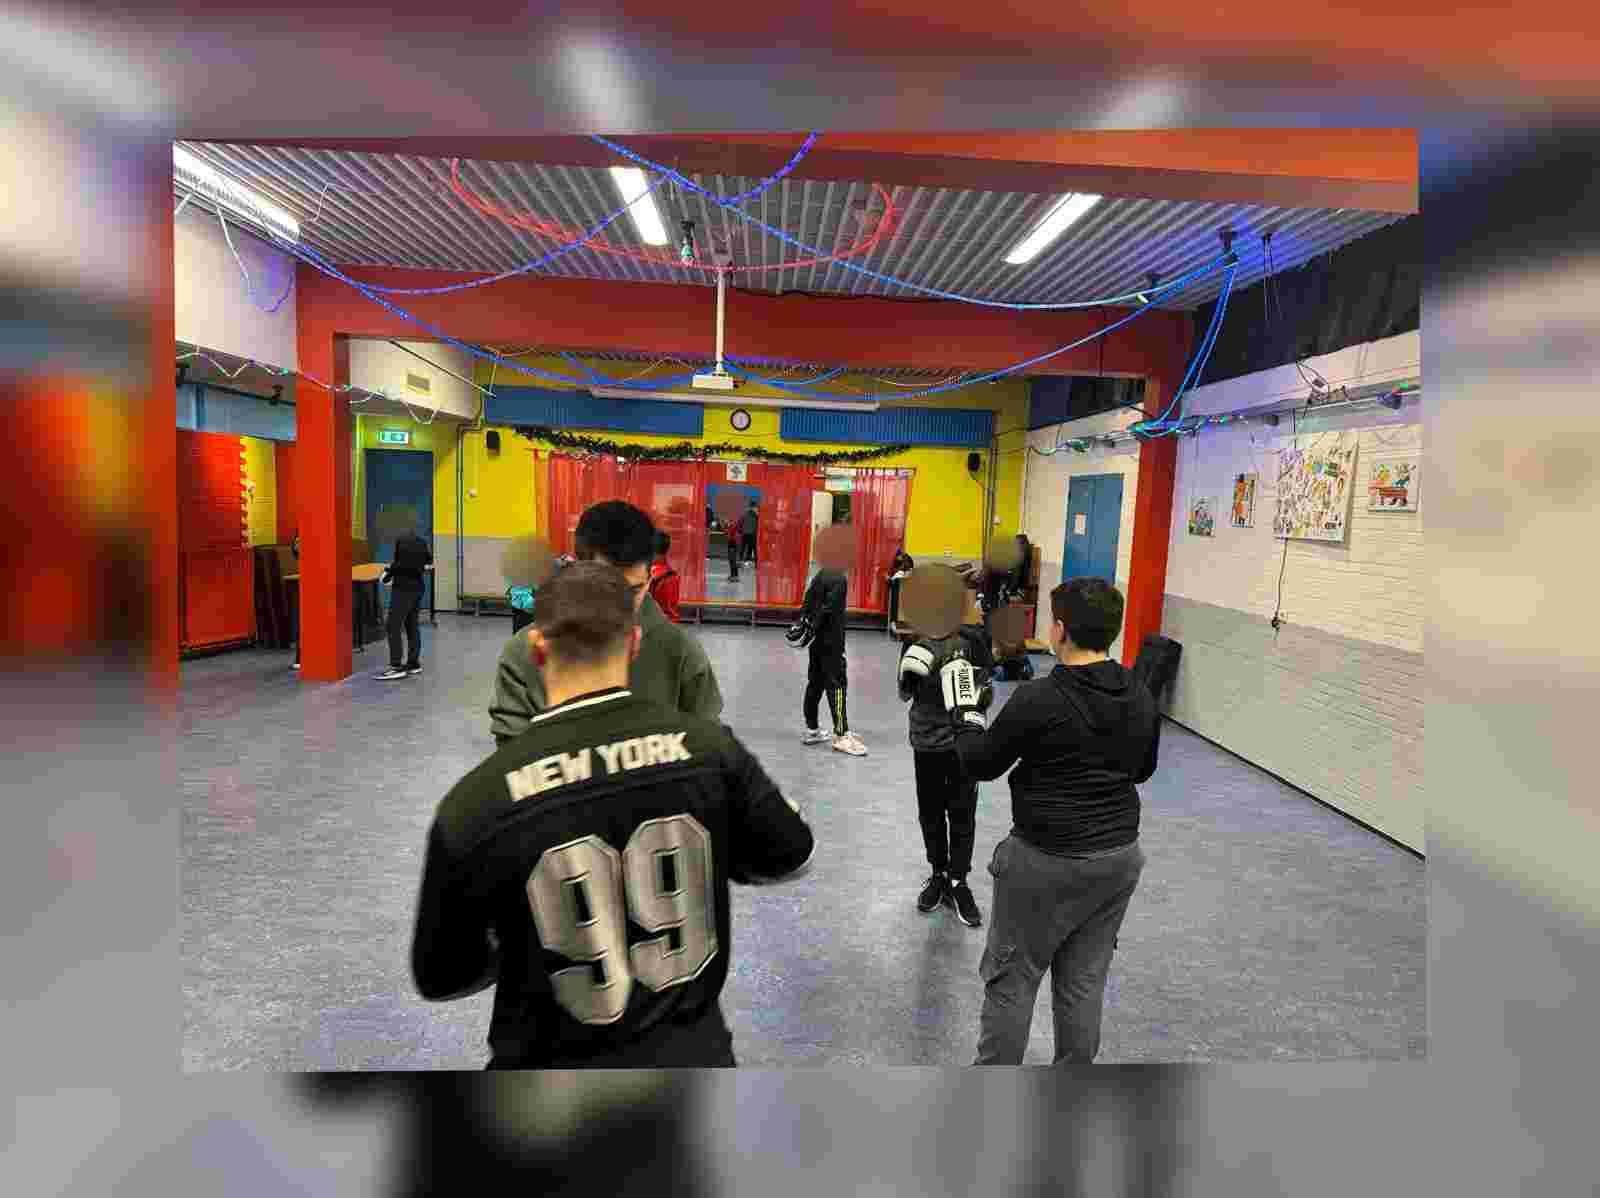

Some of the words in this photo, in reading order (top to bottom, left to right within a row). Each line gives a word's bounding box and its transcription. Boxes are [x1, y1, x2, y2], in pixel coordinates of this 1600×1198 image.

[505, 749, 592, 801] NEW
[597, 732, 692, 773] YORK
[527, 813, 718, 1025] 99
